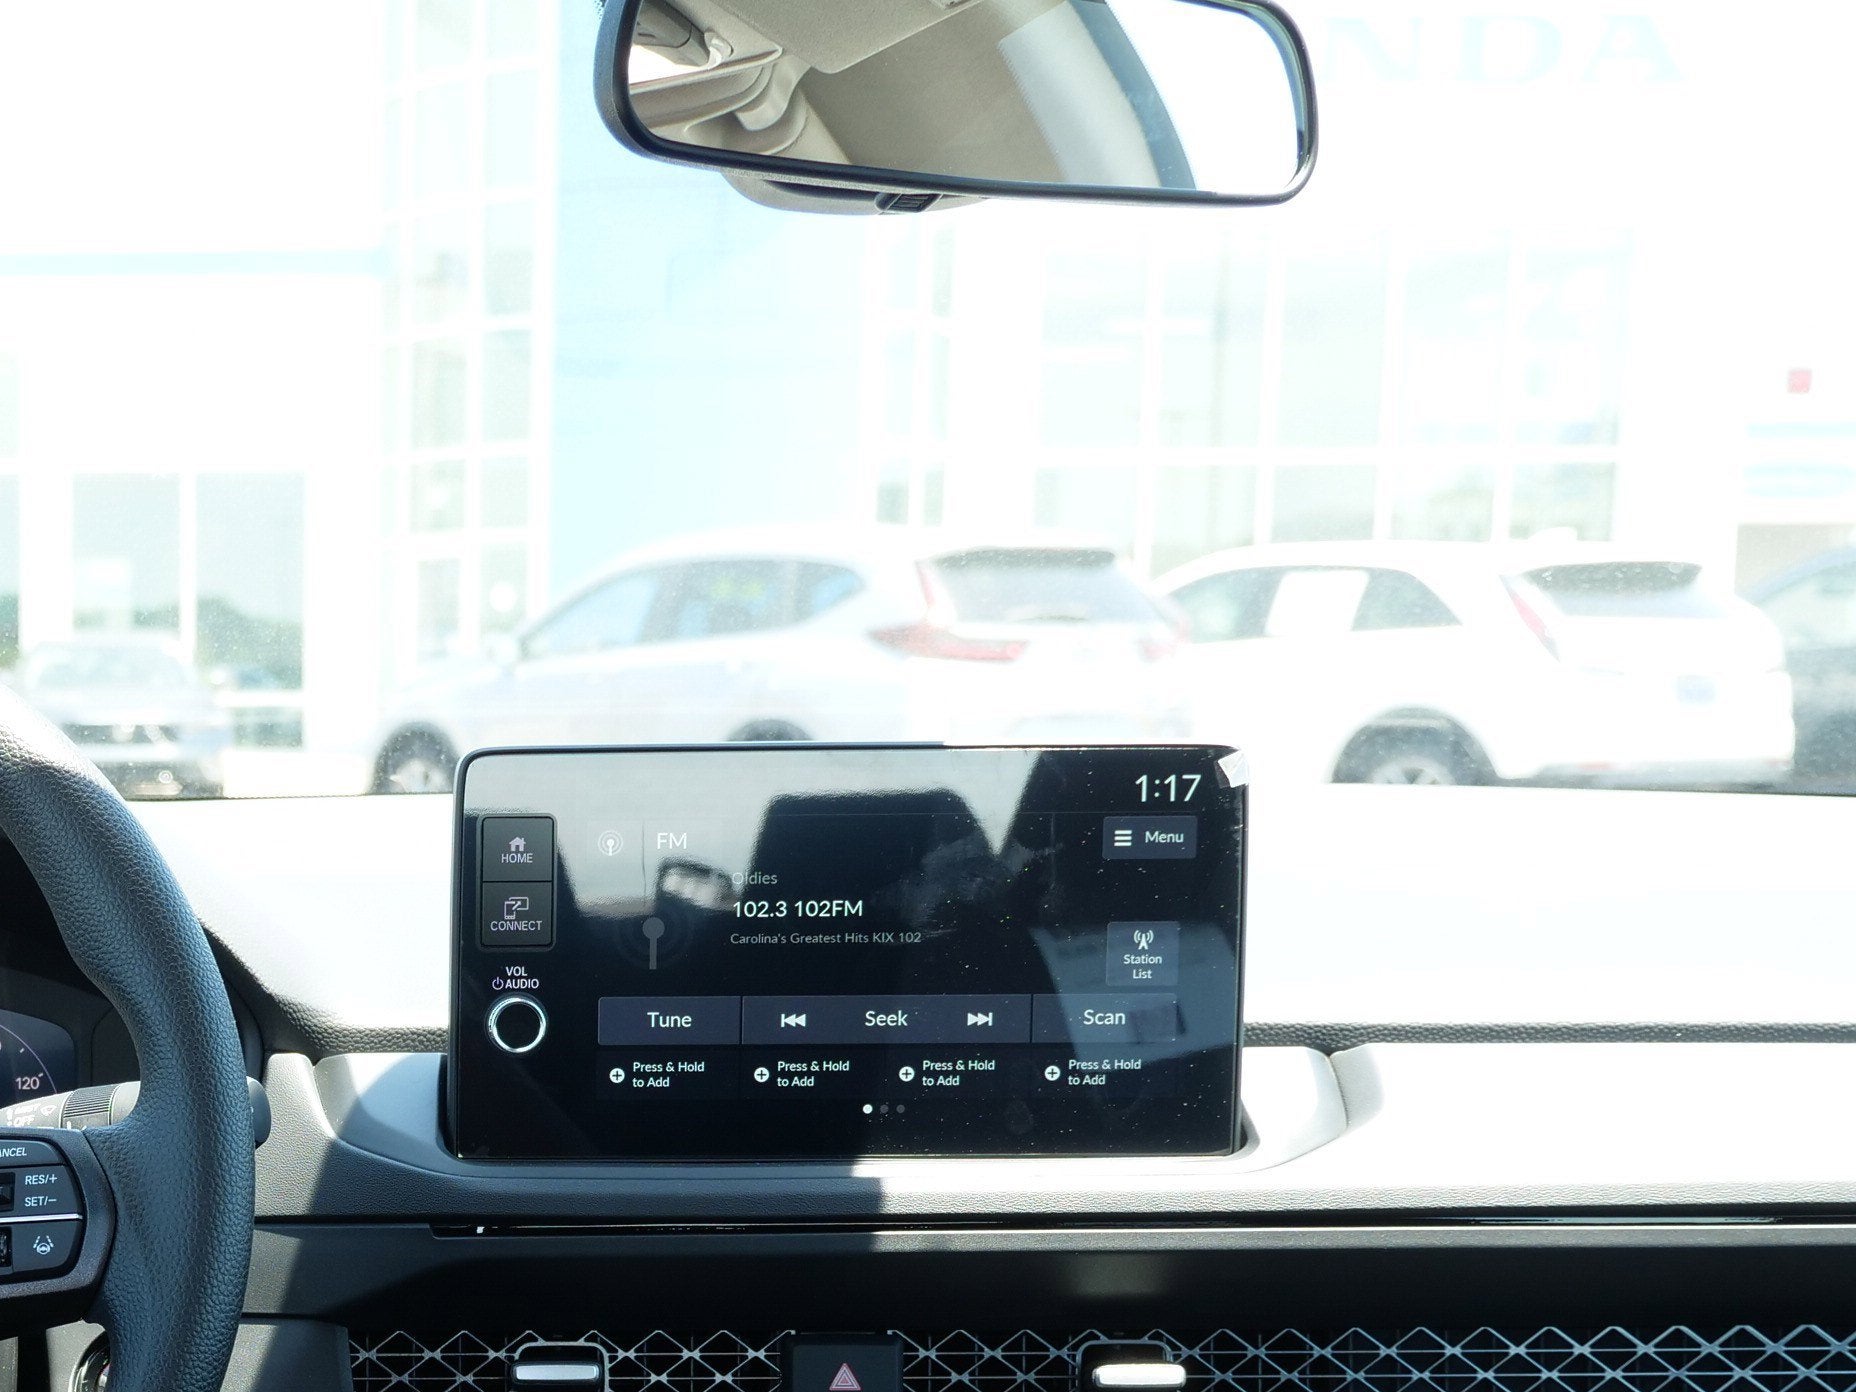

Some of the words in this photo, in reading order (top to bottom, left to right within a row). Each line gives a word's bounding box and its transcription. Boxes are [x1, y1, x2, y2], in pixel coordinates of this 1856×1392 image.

[1135, 774, 1202, 803] 1:17
[656, 832, 688, 850] FM
[1145, 831, 1184, 843] Menu
[501, 853, 533, 863] HOME
[731, 871, 778, 885] Oldies
[733, 901, 788, 918] 102.3
[794, 900, 864, 917] 102FM
[490, 921, 542, 931] CONNECT
[730, 932, 787, 944] Carolina's
[790, 932, 841, 943] Greatest
[845, 932, 869, 943] Hits
[873, 932, 894, 942] KIX
[899, 932, 922, 943] 102
[1123, 954, 1162, 964] Station
[506, 966, 528, 976] VOL
[1133, 969, 1152, 979] List
[505, 978, 539, 989] AUDIO
[646, 1011, 692, 1028] Tune
[864, 1010, 908, 1027] Seek
[1083, 1009, 1126, 1025] Scan
[632, 1061, 664, 1073] Press
[666, 1061, 675, 1073] &
[678, 1061, 705, 1073] Hold
[777, 1060, 808, 1072] Press
[810, 1060, 819, 1072] &
[823, 1060, 850, 1072] Hold
[922, 1060, 954, 1072] Press
[956, 1060, 965, 1072] &
[968, 1060, 995, 1072] Hold
[1068, 1059, 1100, 1071] Press
[1102, 1059, 1111, 1071] &
[1115, 1059, 1142, 1071] Hold
[15, 1077, 40, 1090] 120
[632, 1077, 644, 1088] to
[647, 1077, 670, 1088] Add
[777, 1076, 789, 1087] to
[792, 1076, 815, 1087] Add
[922, 1075, 934, 1086] to
[937, 1075, 960, 1086] Add
[1068, 1074, 1080, 1085] to
[1083, 1074, 1106, 1085] Add
[24, 1174, 58, 1185] RES/+
